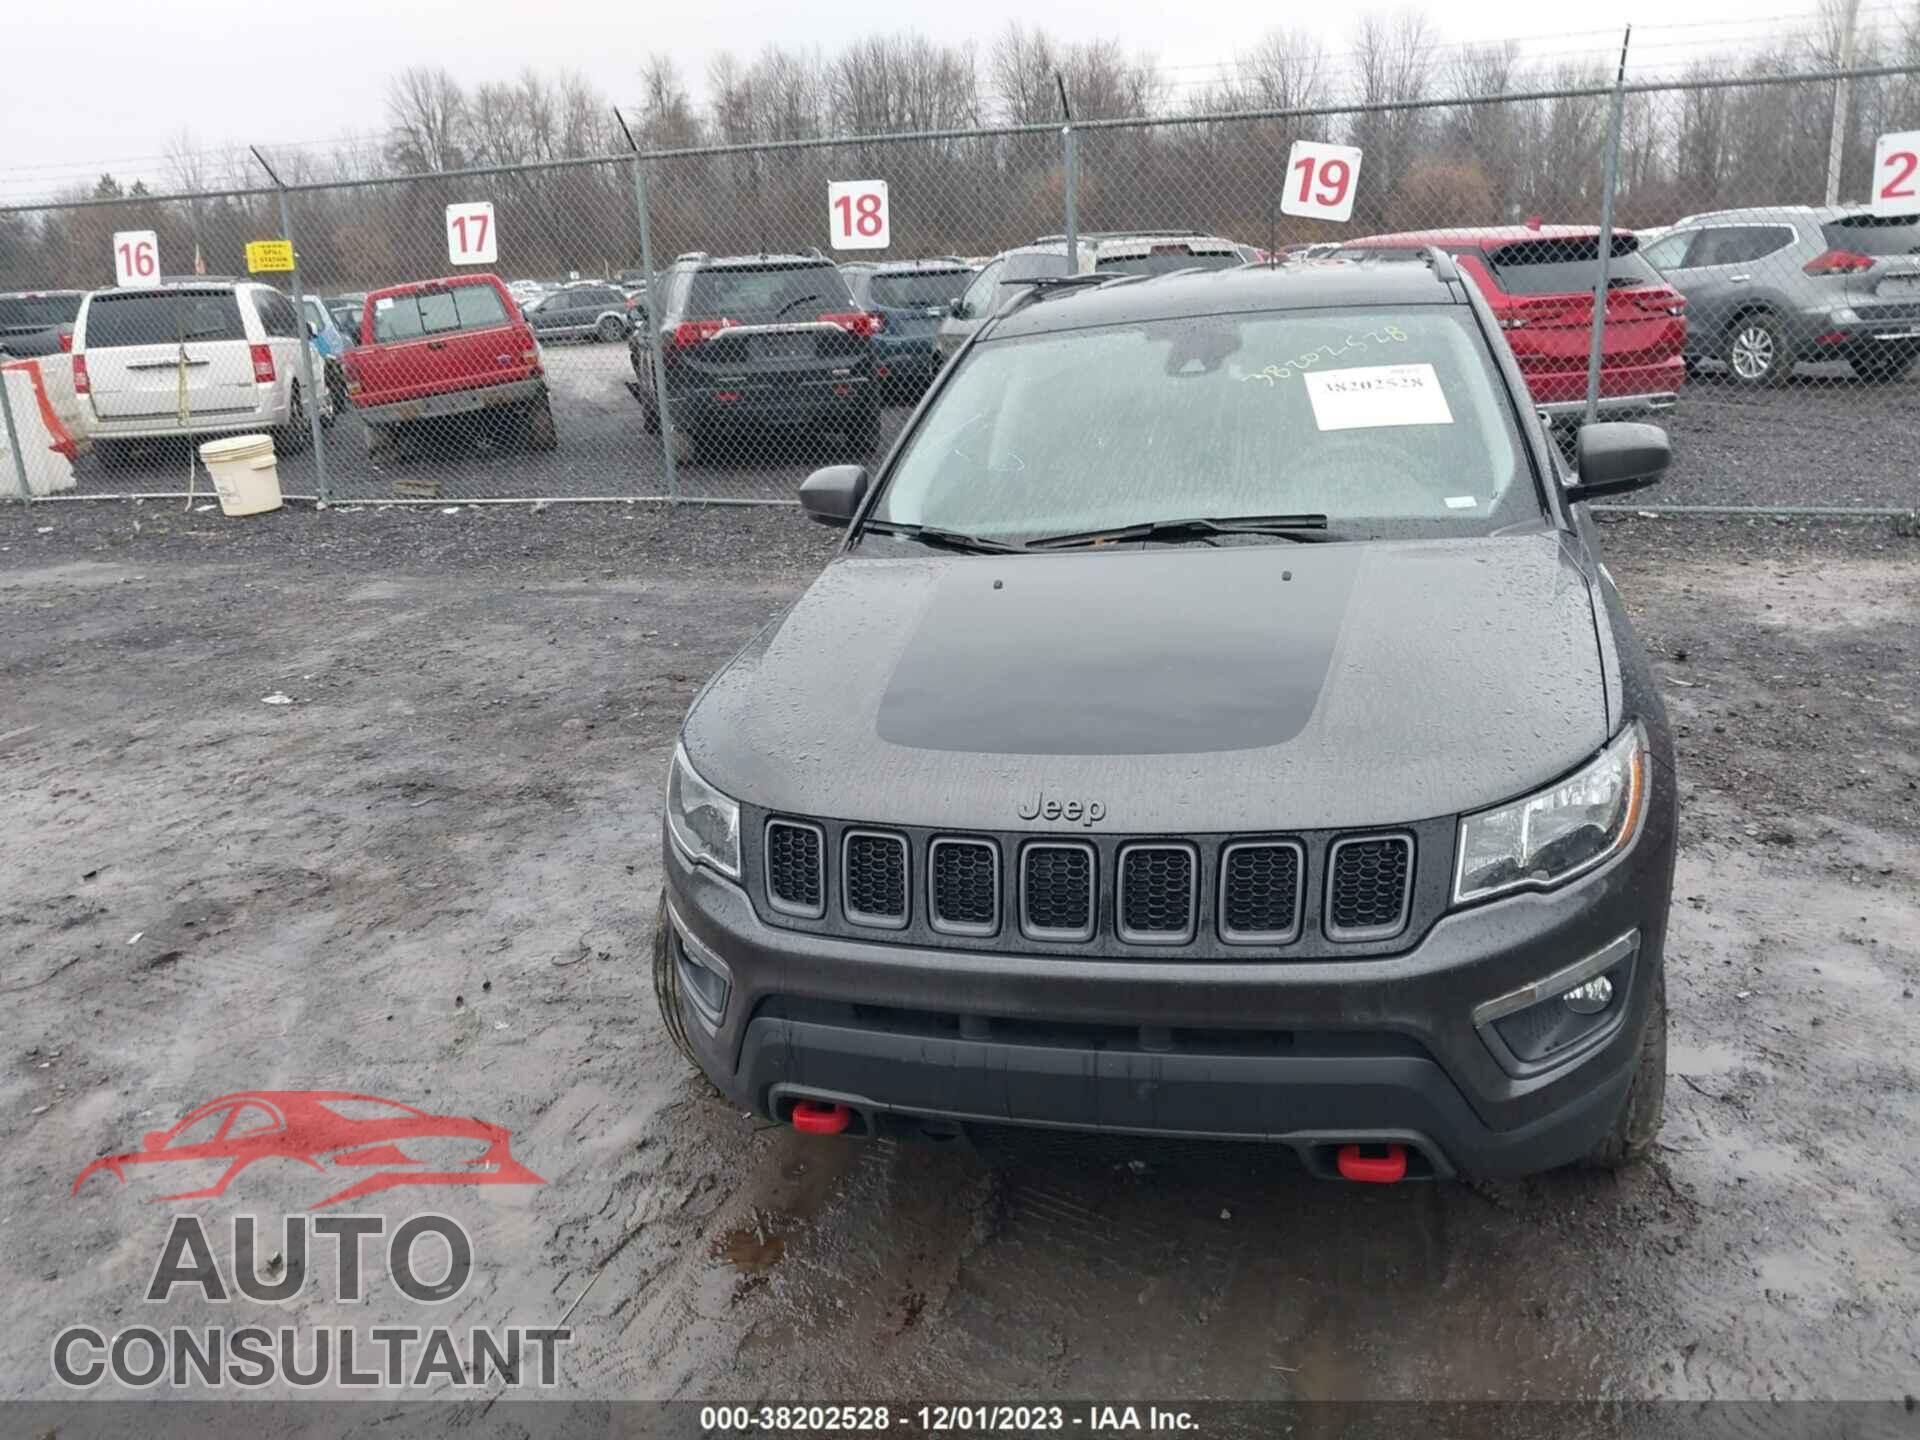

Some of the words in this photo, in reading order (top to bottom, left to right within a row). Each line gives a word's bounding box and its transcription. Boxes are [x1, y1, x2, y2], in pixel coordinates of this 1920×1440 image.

[1294, 156, 1350, 207] 19
[452, 214, 489, 253] 17
[834, 194, 882, 237] 18
[119, 241, 155, 277] 16
[1018, 791, 1106, 827] Jeep
